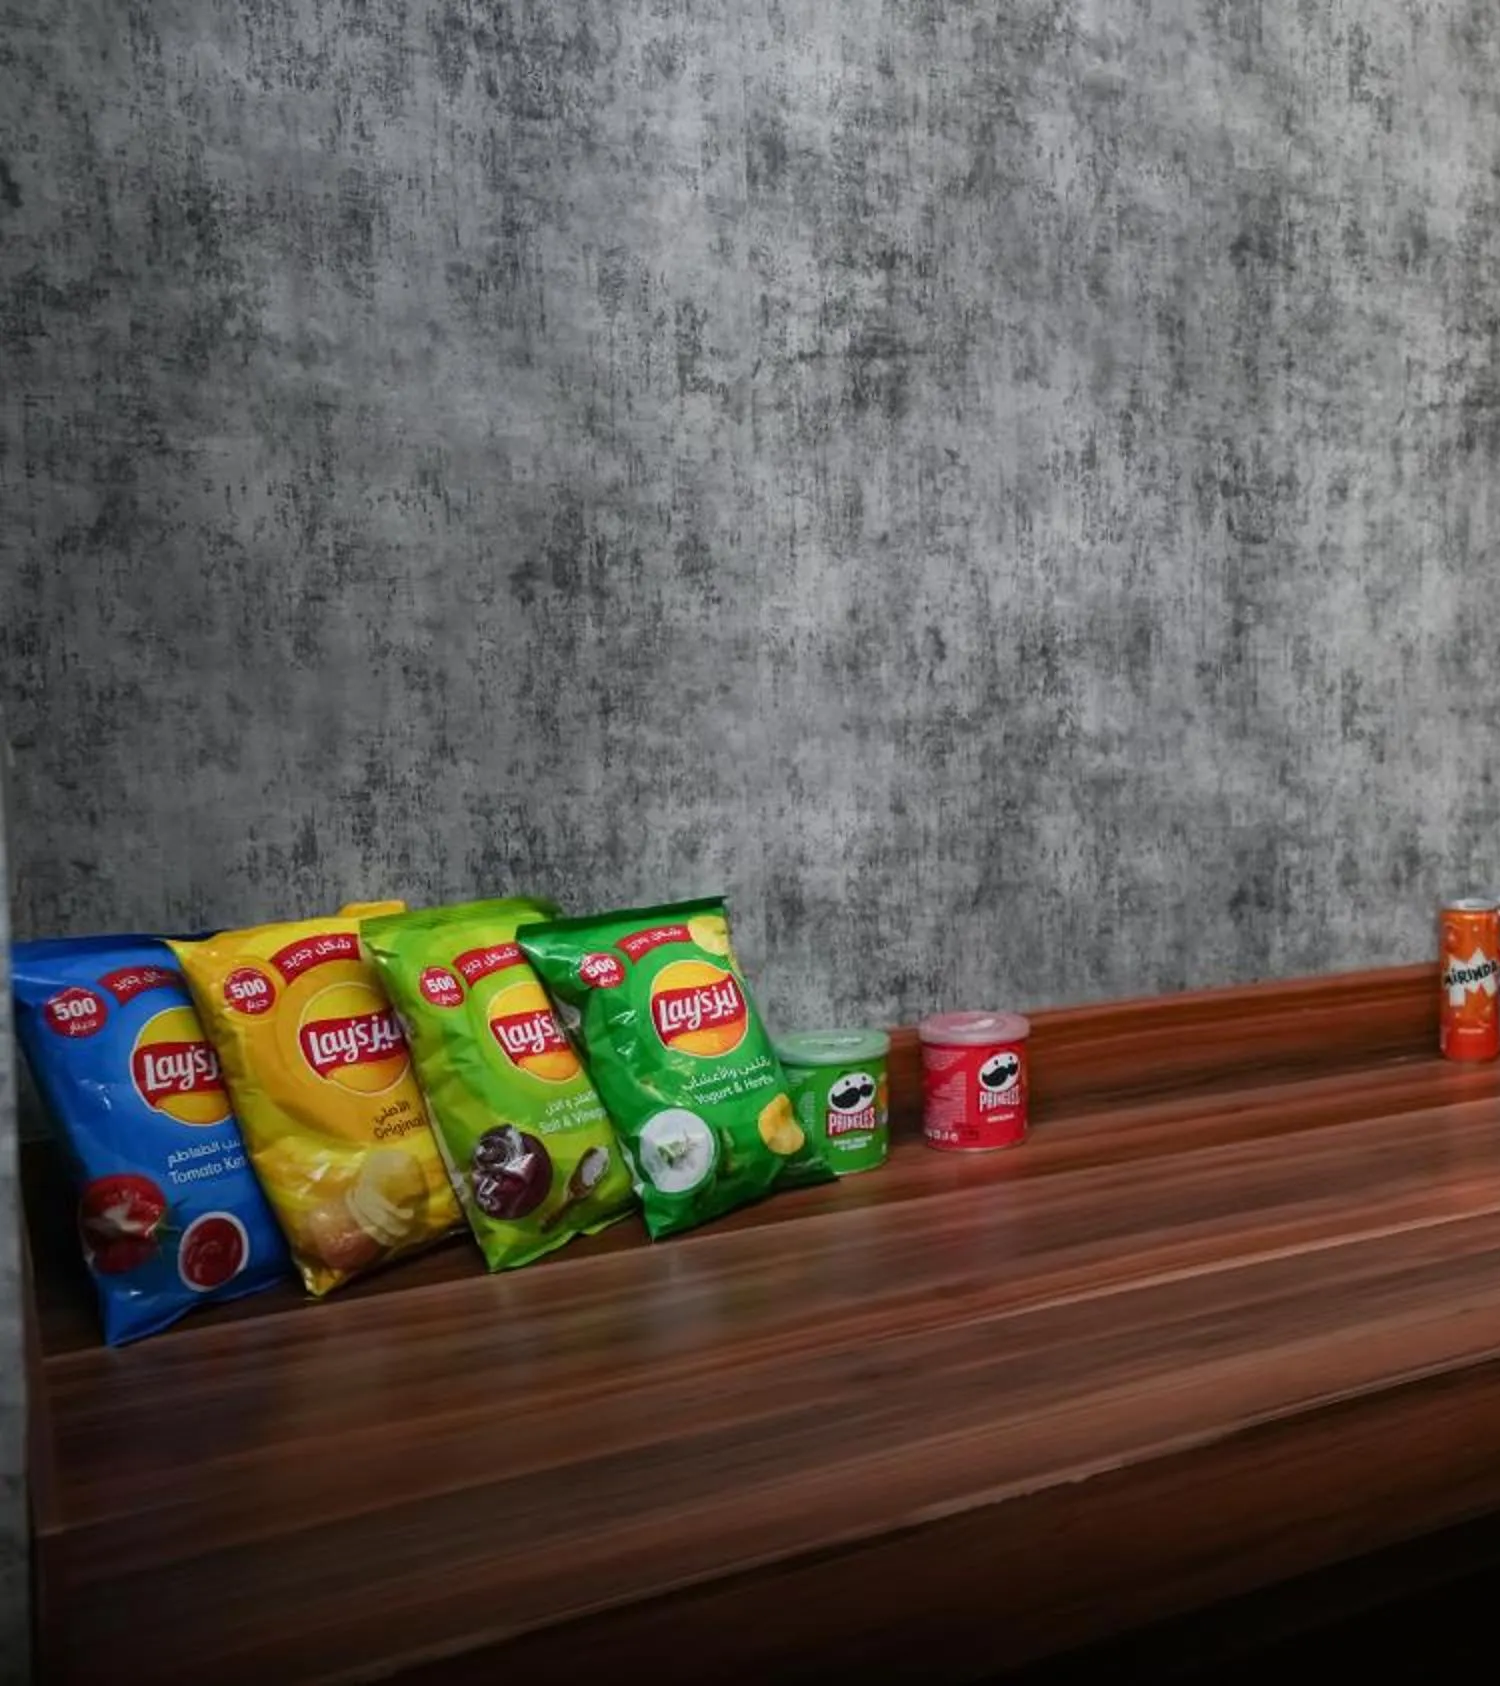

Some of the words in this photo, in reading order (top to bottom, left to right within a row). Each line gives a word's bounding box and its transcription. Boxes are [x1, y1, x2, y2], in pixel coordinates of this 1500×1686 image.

[585, 958, 617, 978] 500
[230, 978, 267, 999] 500
[426, 975, 457, 993] 500
[53, 997, 97, 1020] 500
[659, 987, 714, 1033] Lay's
[308, 1019, 368, 1065] Lay's
[496, 1012, 554, 1053] Lay's
[143, 1045, 208, 1091] Lay's
[374, 1111, 426, 1140] Original
[168, 1162, 222, 1185] Tomato
